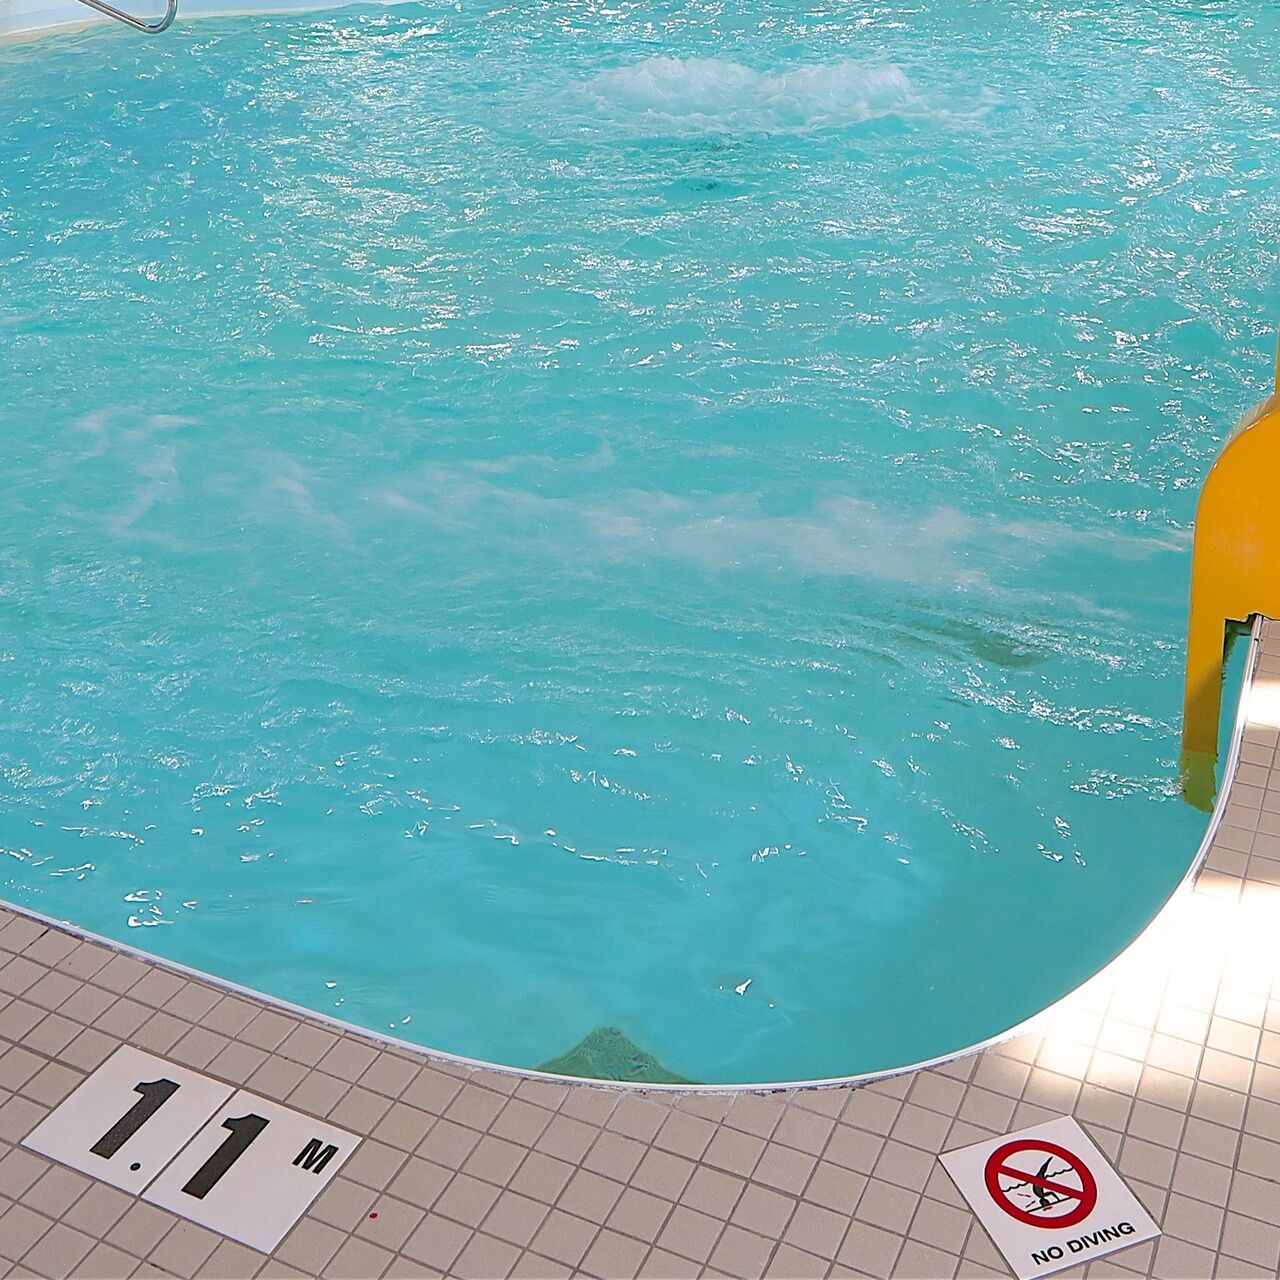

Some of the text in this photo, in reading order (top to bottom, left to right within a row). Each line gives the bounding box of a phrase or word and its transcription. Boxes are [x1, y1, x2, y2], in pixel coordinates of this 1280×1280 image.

[89, 1077, 339, 1200] 1.1 M
[1031, 1222, 1136, 1265] NO DIVING
